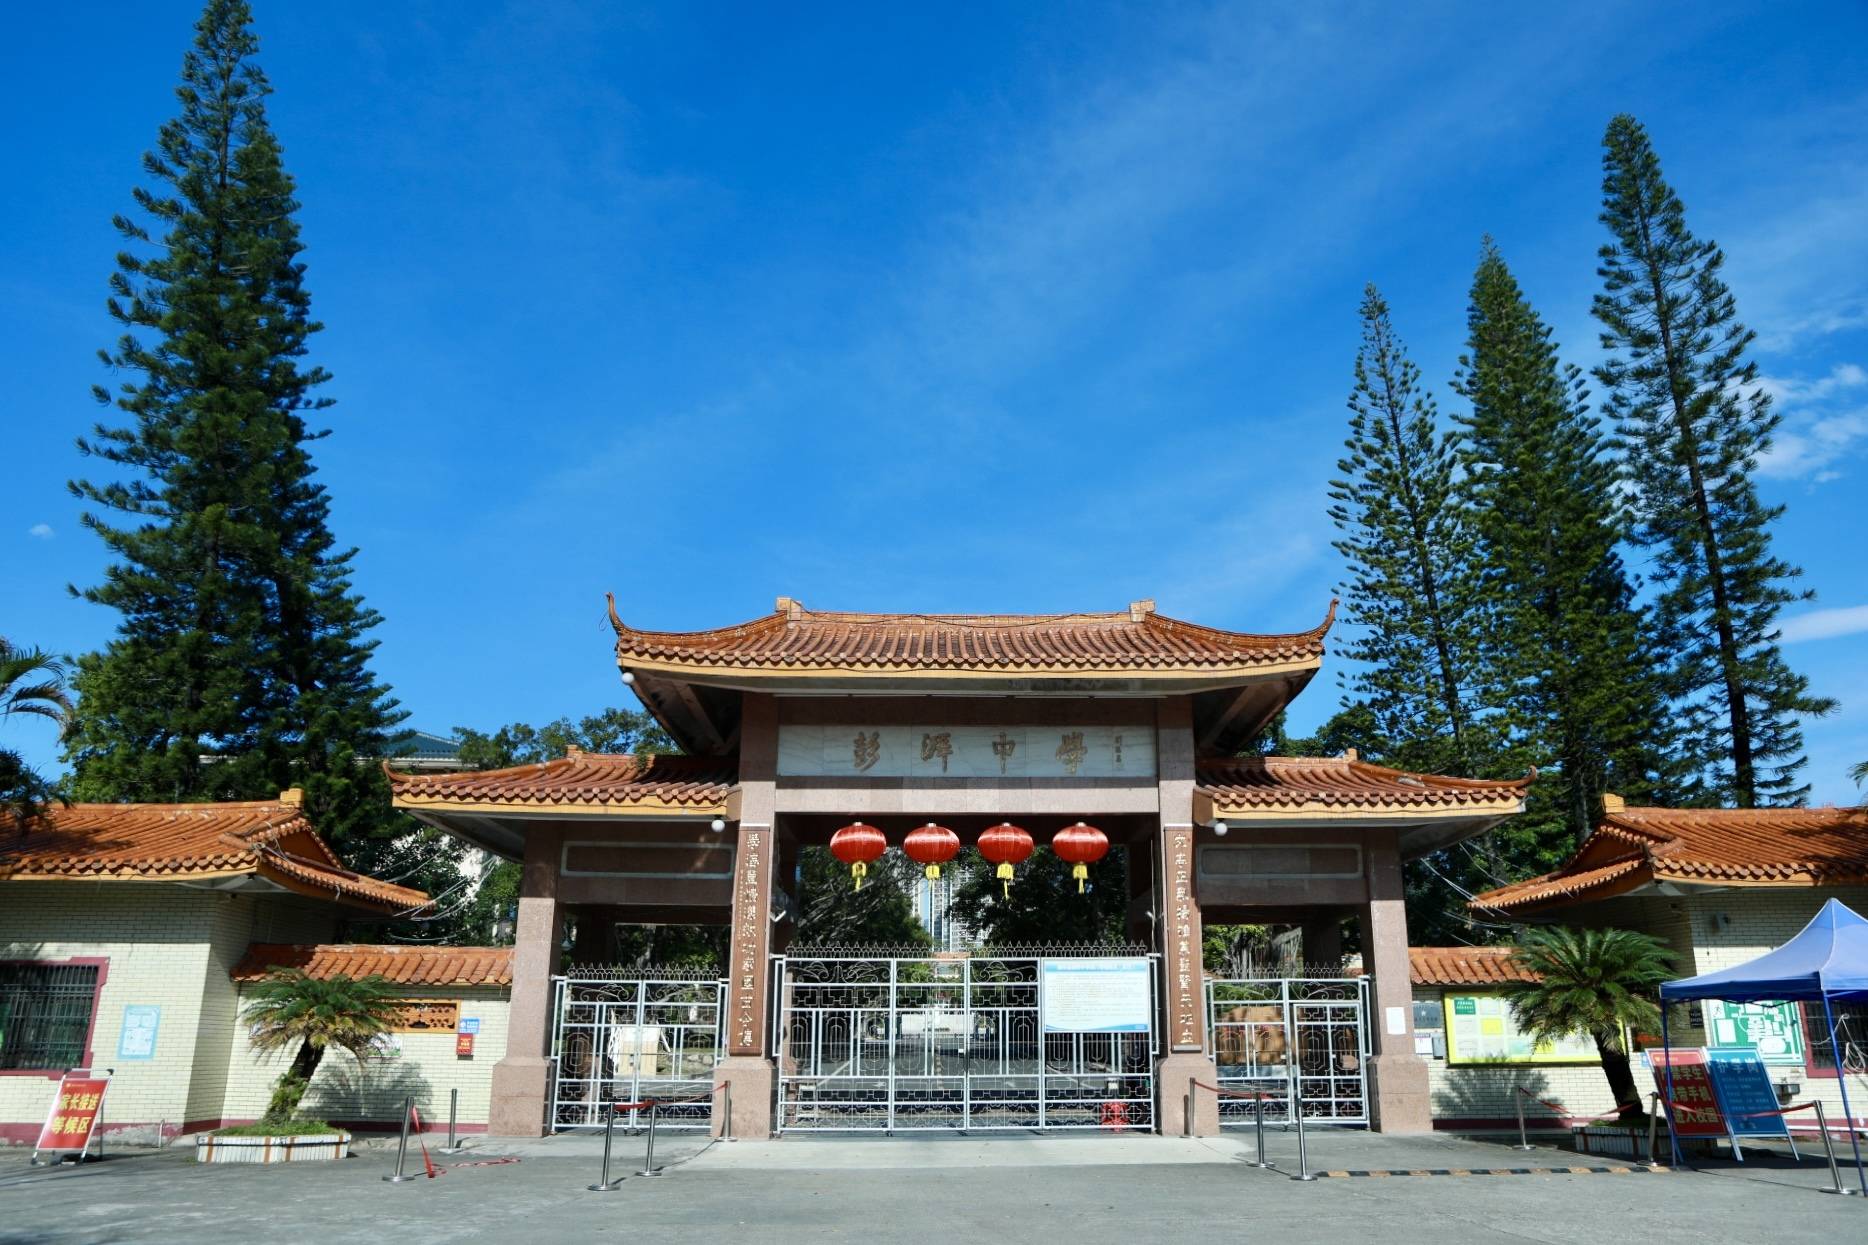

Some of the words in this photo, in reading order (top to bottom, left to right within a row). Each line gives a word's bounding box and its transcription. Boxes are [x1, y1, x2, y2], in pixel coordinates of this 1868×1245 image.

[57, 1092, 100, 1111] 家长接送
[51, 1116, 93, 1135] 等候区
